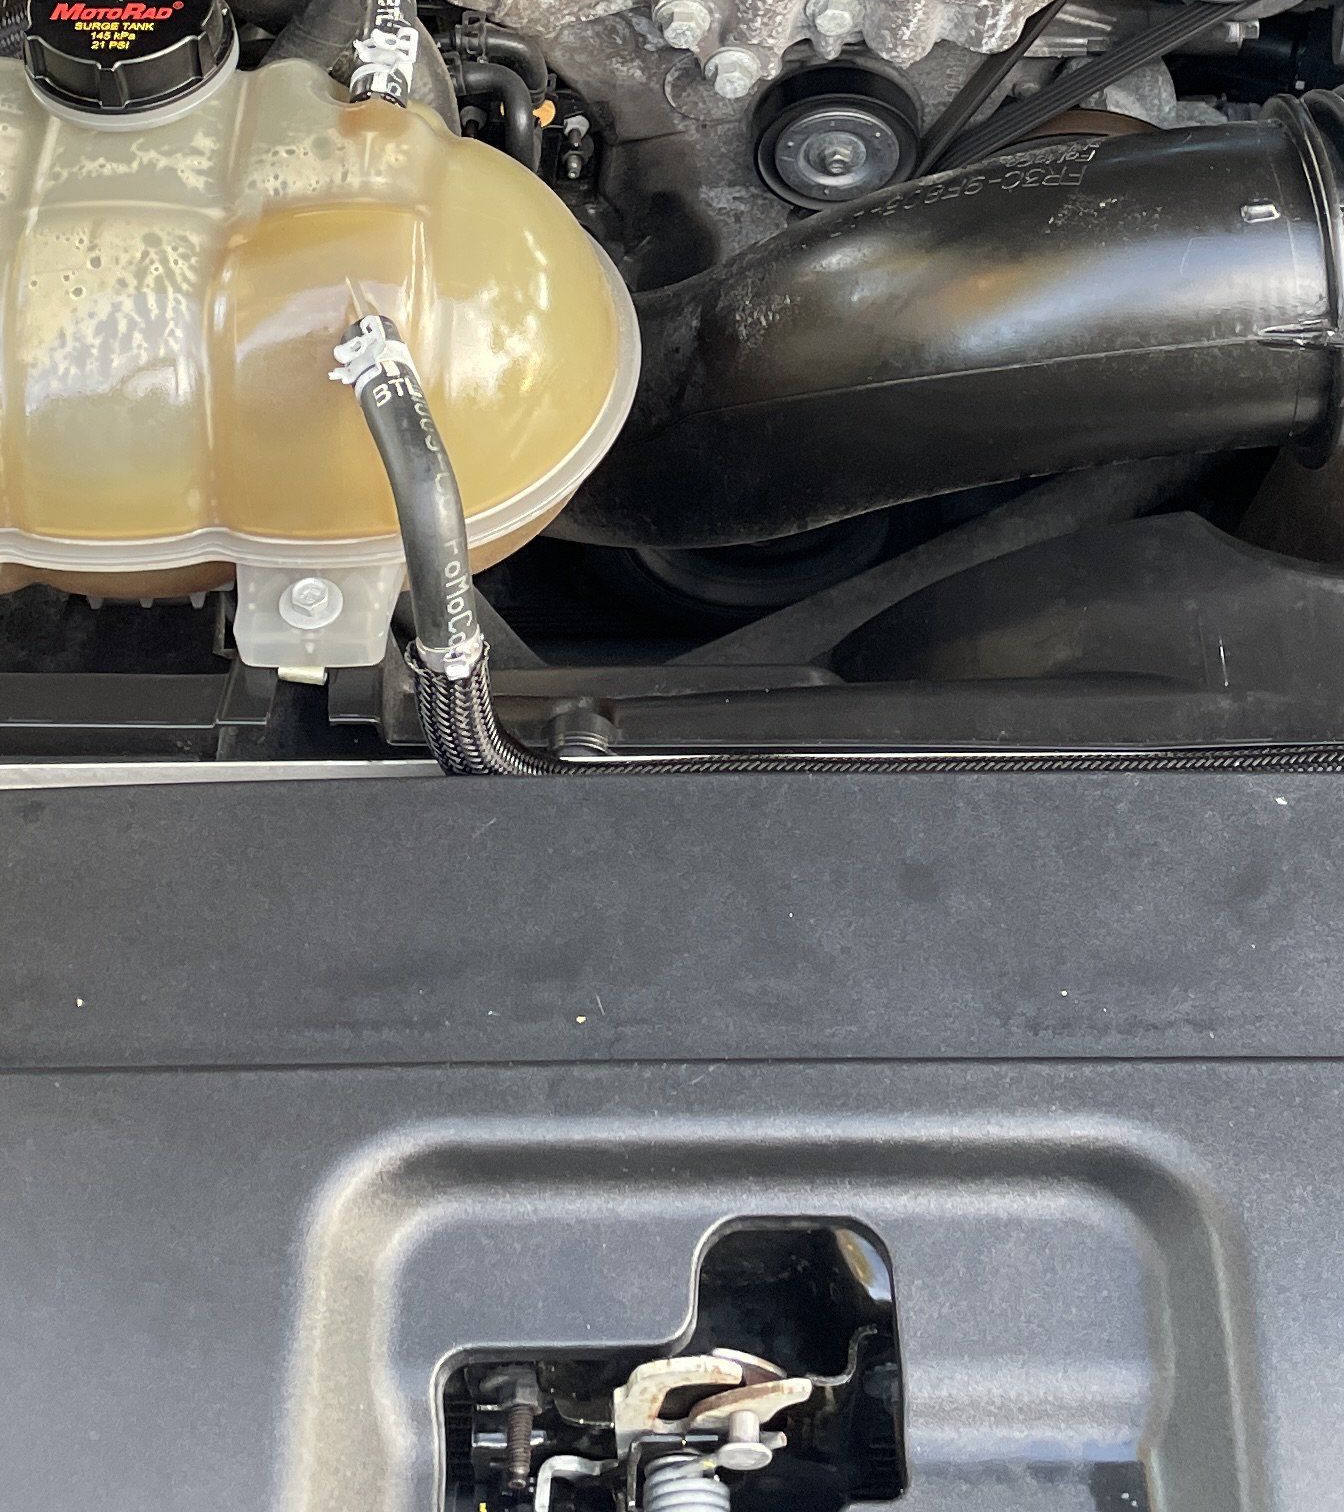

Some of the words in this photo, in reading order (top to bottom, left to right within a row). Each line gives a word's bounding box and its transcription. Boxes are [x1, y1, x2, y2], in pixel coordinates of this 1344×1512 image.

[74, 22, 120, 31] SURGE
[122, 22, 155, 31] TANK
[90, 31, 111, 40] 145
[113, 31, 136, 40] kPa
[90, 40, 106, 49] 21
[108, 40, 130, 49] PSI
[372, 376, 423, 408] BTL
